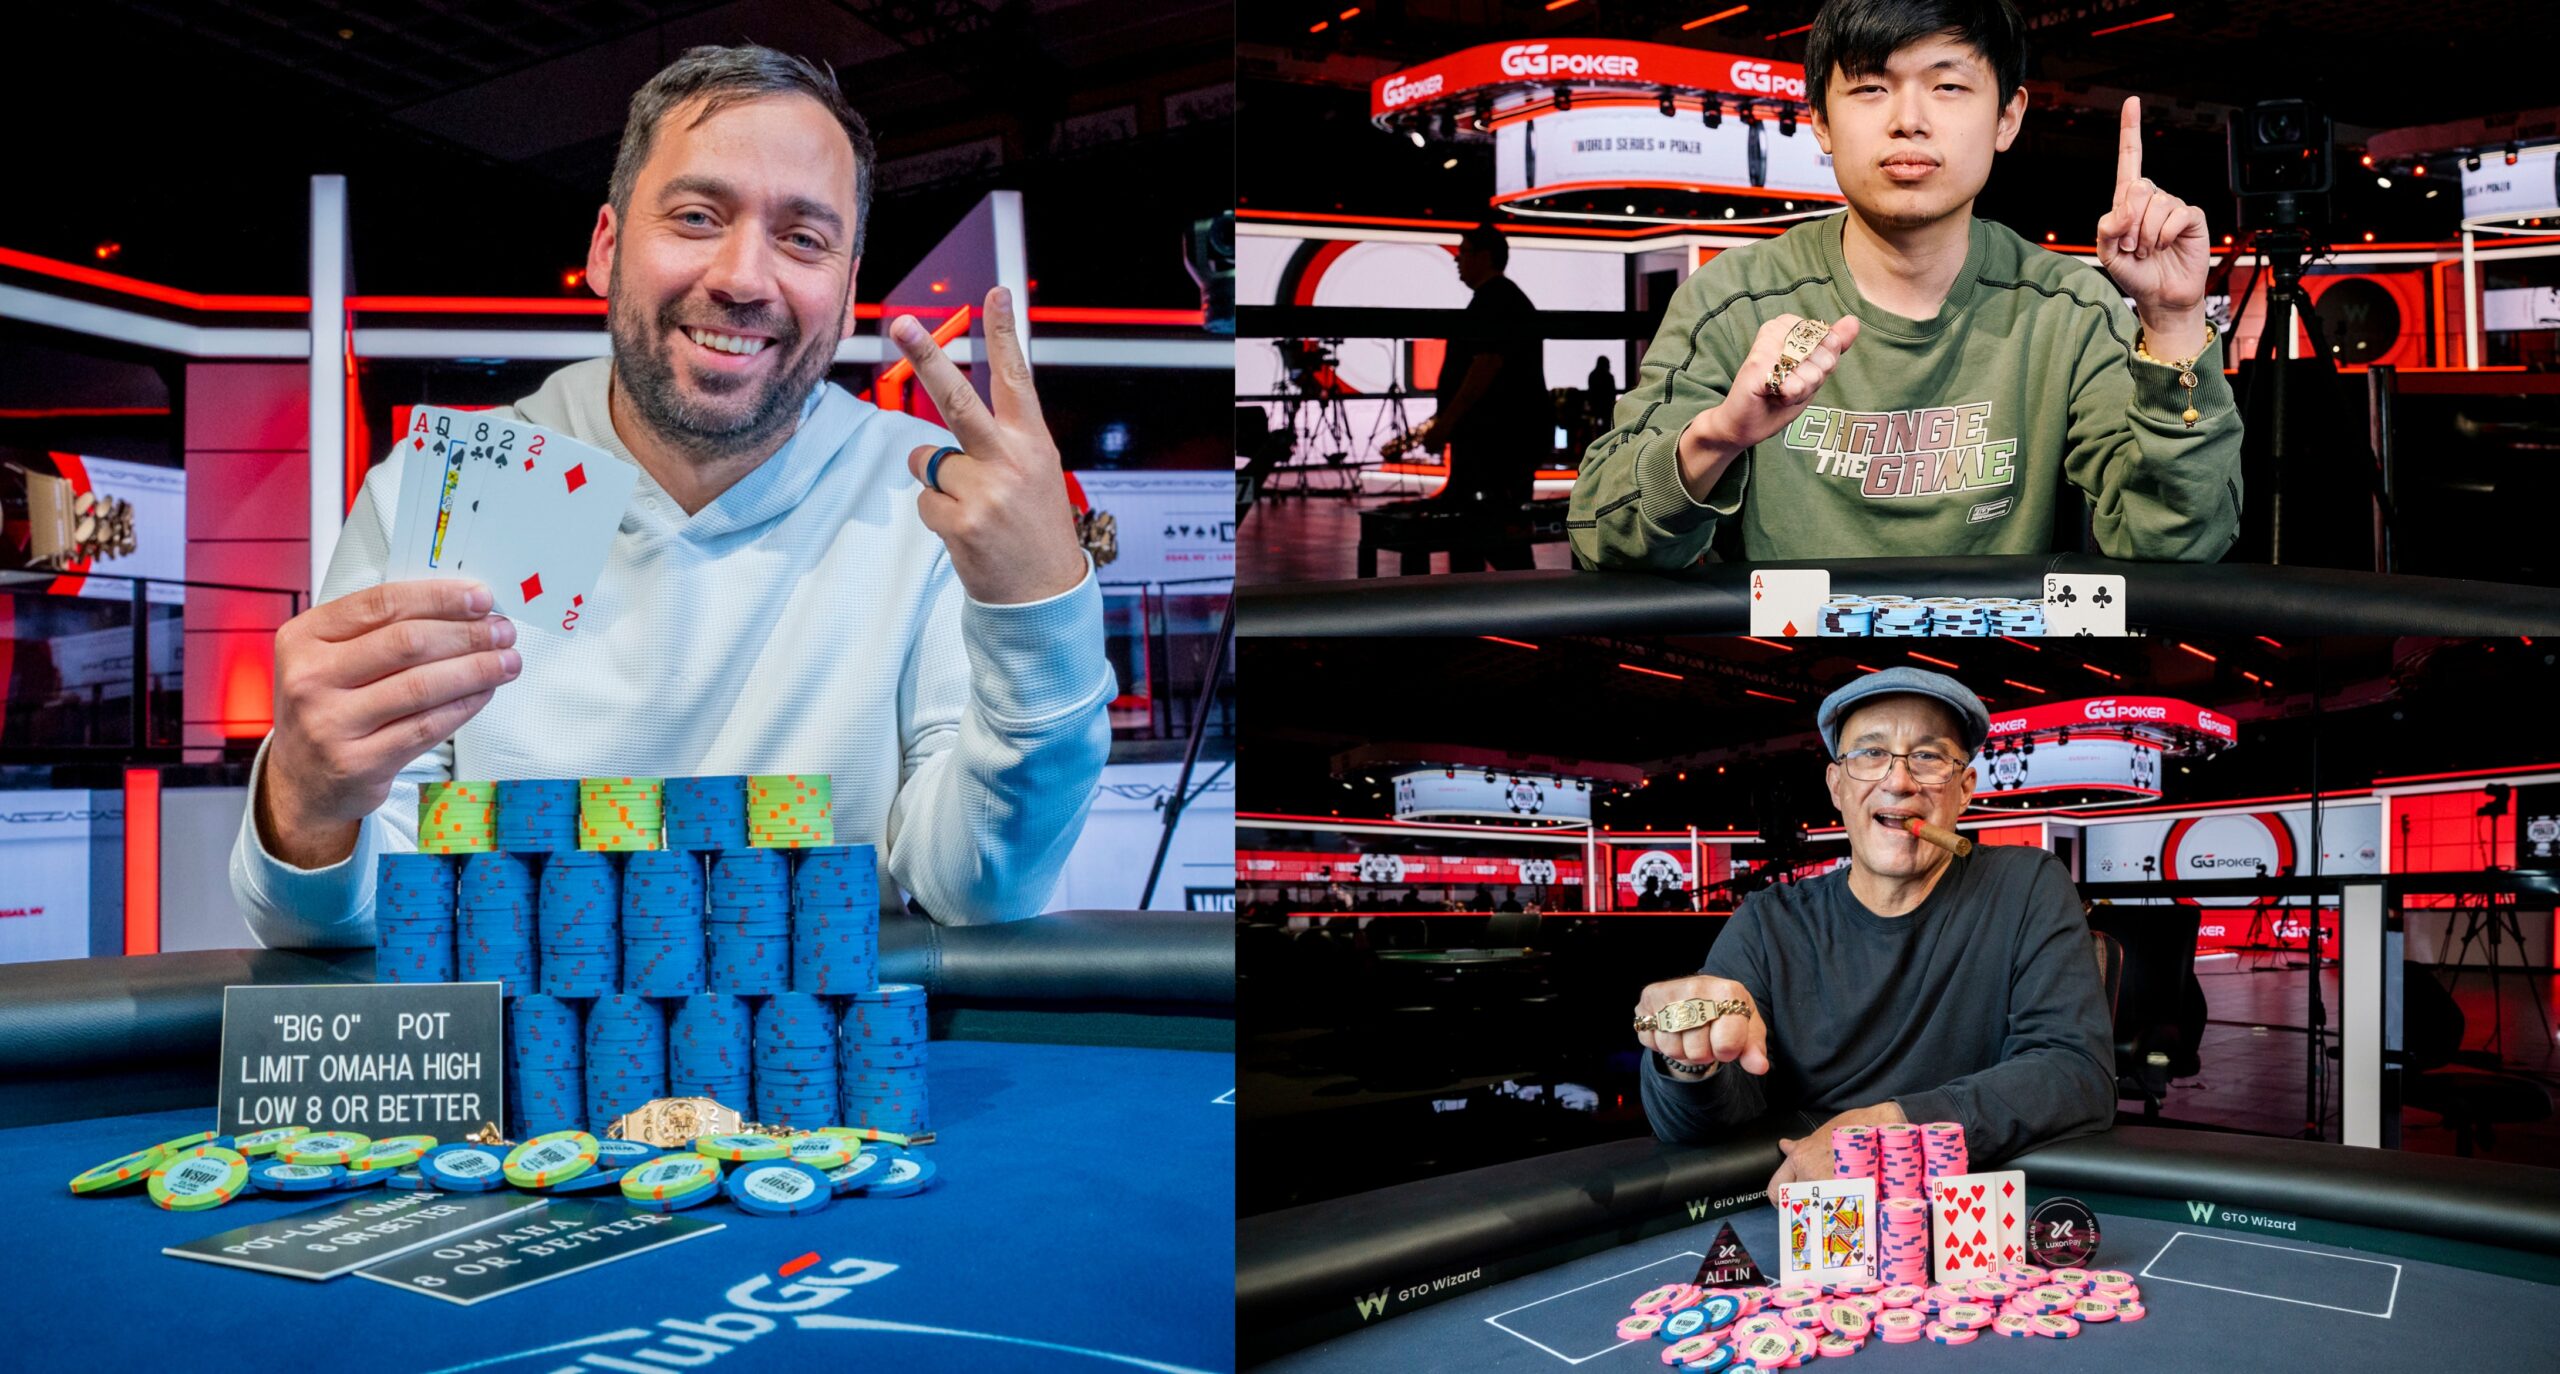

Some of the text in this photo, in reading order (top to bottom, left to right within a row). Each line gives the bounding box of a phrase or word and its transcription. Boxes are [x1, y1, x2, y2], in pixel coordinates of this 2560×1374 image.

[1670, 139, 1701, 154] POKER
[413, 412, 429, 433] A
[435, 416, 451, 439] Q
[475, 422, 489, 442] 8
[1784, 400, 1992, 455] CHANGE
[499, 430, 515, 450] 2
[528, 435, 545, 456] 2
[1815, 437, 2018, 498] THE GAME
[1752, 575, 1764, 589] A
[2048, 578, 2057, 593] 5
[562, 610, 580, 631] 2
[274, 1014, 323, 1042] "BIG
[398, 1013, 450, 1040] POT
[241, 1052, 481, 1083] LIMIT OMAHA HIGH
[238, 1093, 481, 1124] LOW 8 OR BETTER
[180, 1167, 218, 1183] WSOP
[1781, 1188, 1790, 1199] K
[1812, 1186, 1820, 1198] Q
[1934, 1182, 1943, 1194] 10
[354, 1192, 444, 1218] OMAHA
[1714, 1197, 1734, 1210] GTO
[330, 1226, 380, 1246] OR
[365, 1204, 467, 1235] BETTER
[2221, 1211, 2248, 1224] GTO
[2251, 1215, 2296, 1231] Wizard
[433, 1219, 583, 1260] OMAHA
[413, 1214, 673, 1288] 8 OR BETTER
[1398, 1283, 1429, 1301] GTO
[1432, 1267, 1480, 1291] Wizard
[1705, 1267, 1750, 1284] ALL IN
[549, 1251, 900, 1374] lubGG
